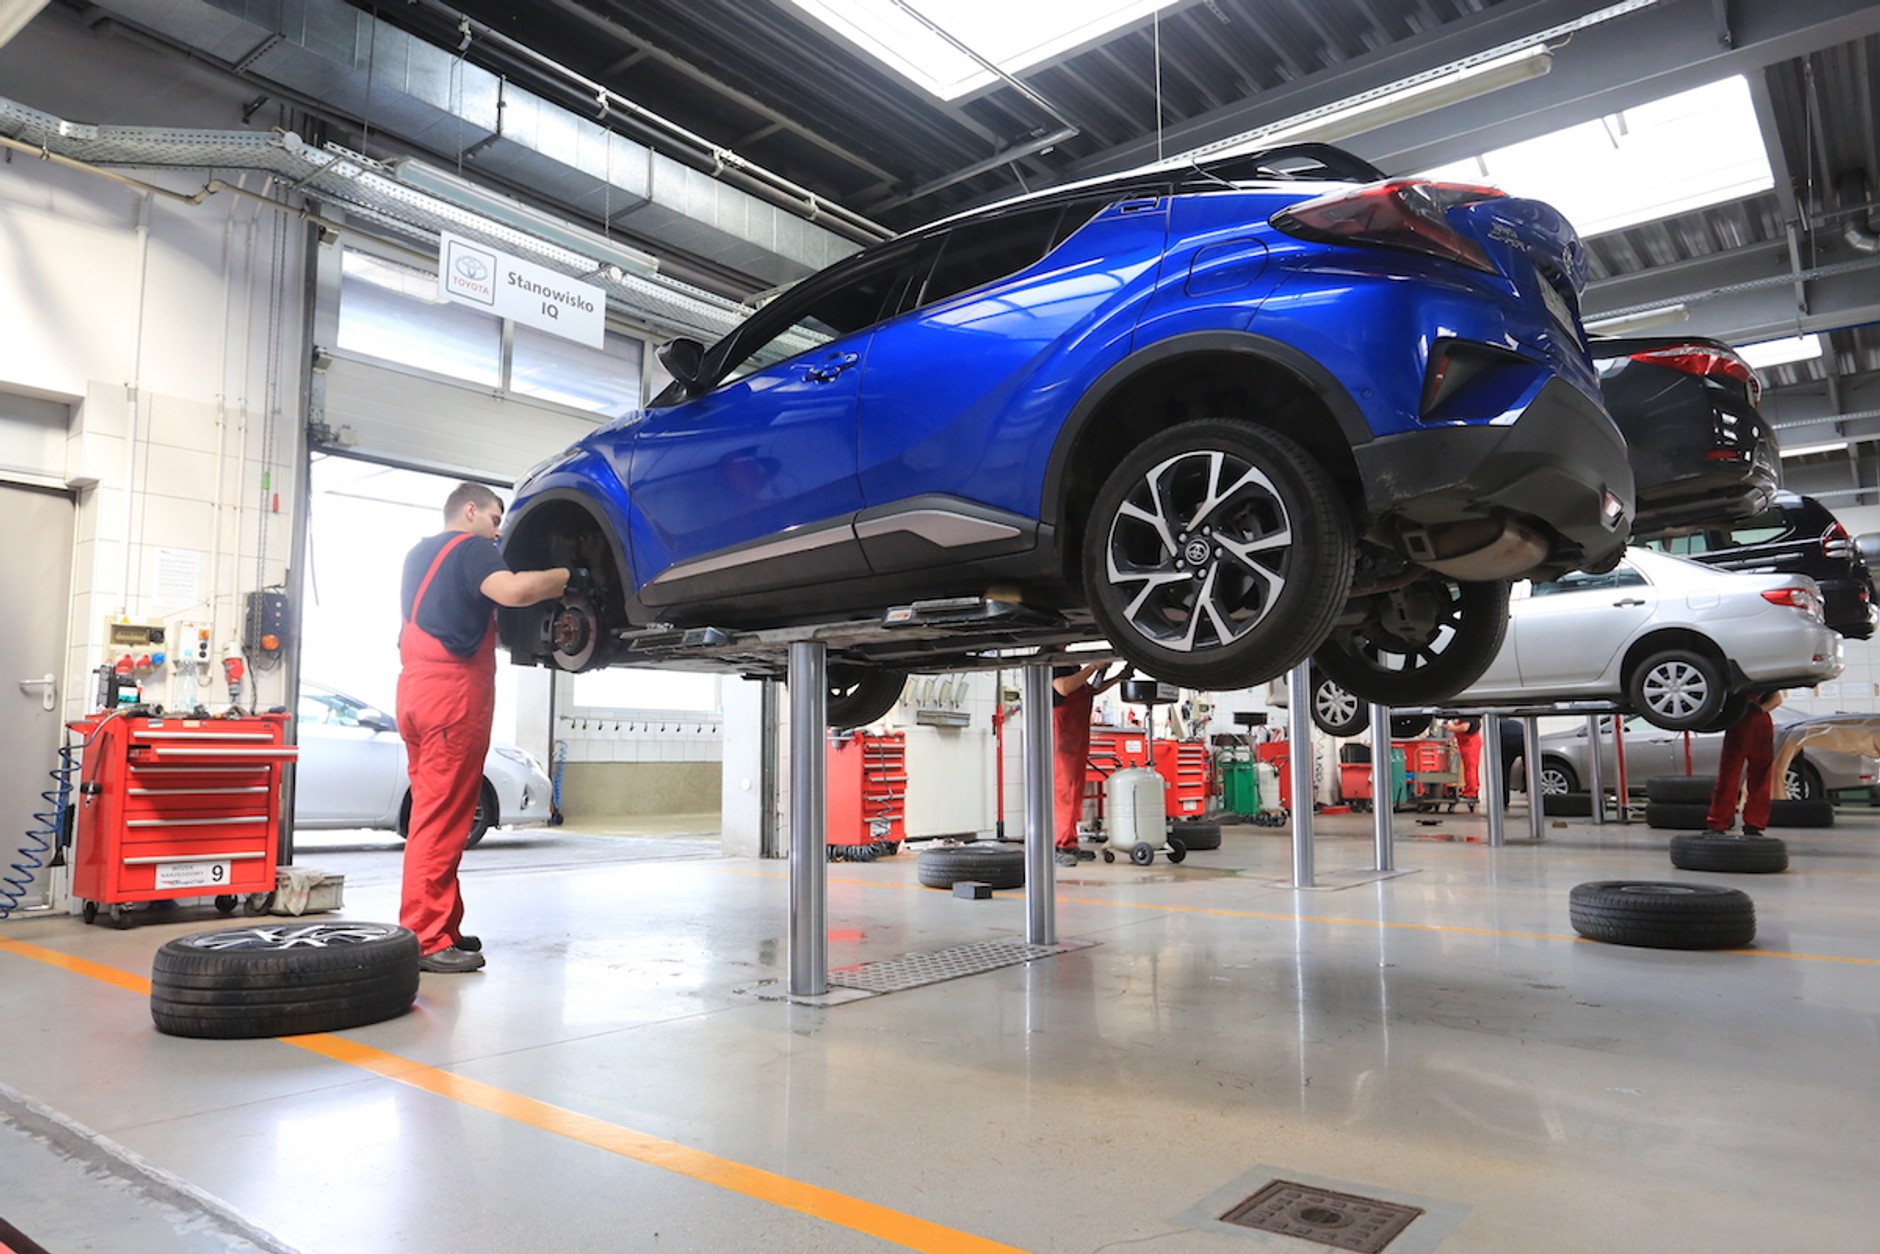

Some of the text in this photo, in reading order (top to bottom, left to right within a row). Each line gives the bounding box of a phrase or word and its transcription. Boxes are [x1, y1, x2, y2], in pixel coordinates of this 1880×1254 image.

[453, 276, 489, 295] TOYOTA
[508, 271, 594, 313] Stanowisko
[541, 302, 559, 320] IQ
[212, 864, 224, 882] 9
